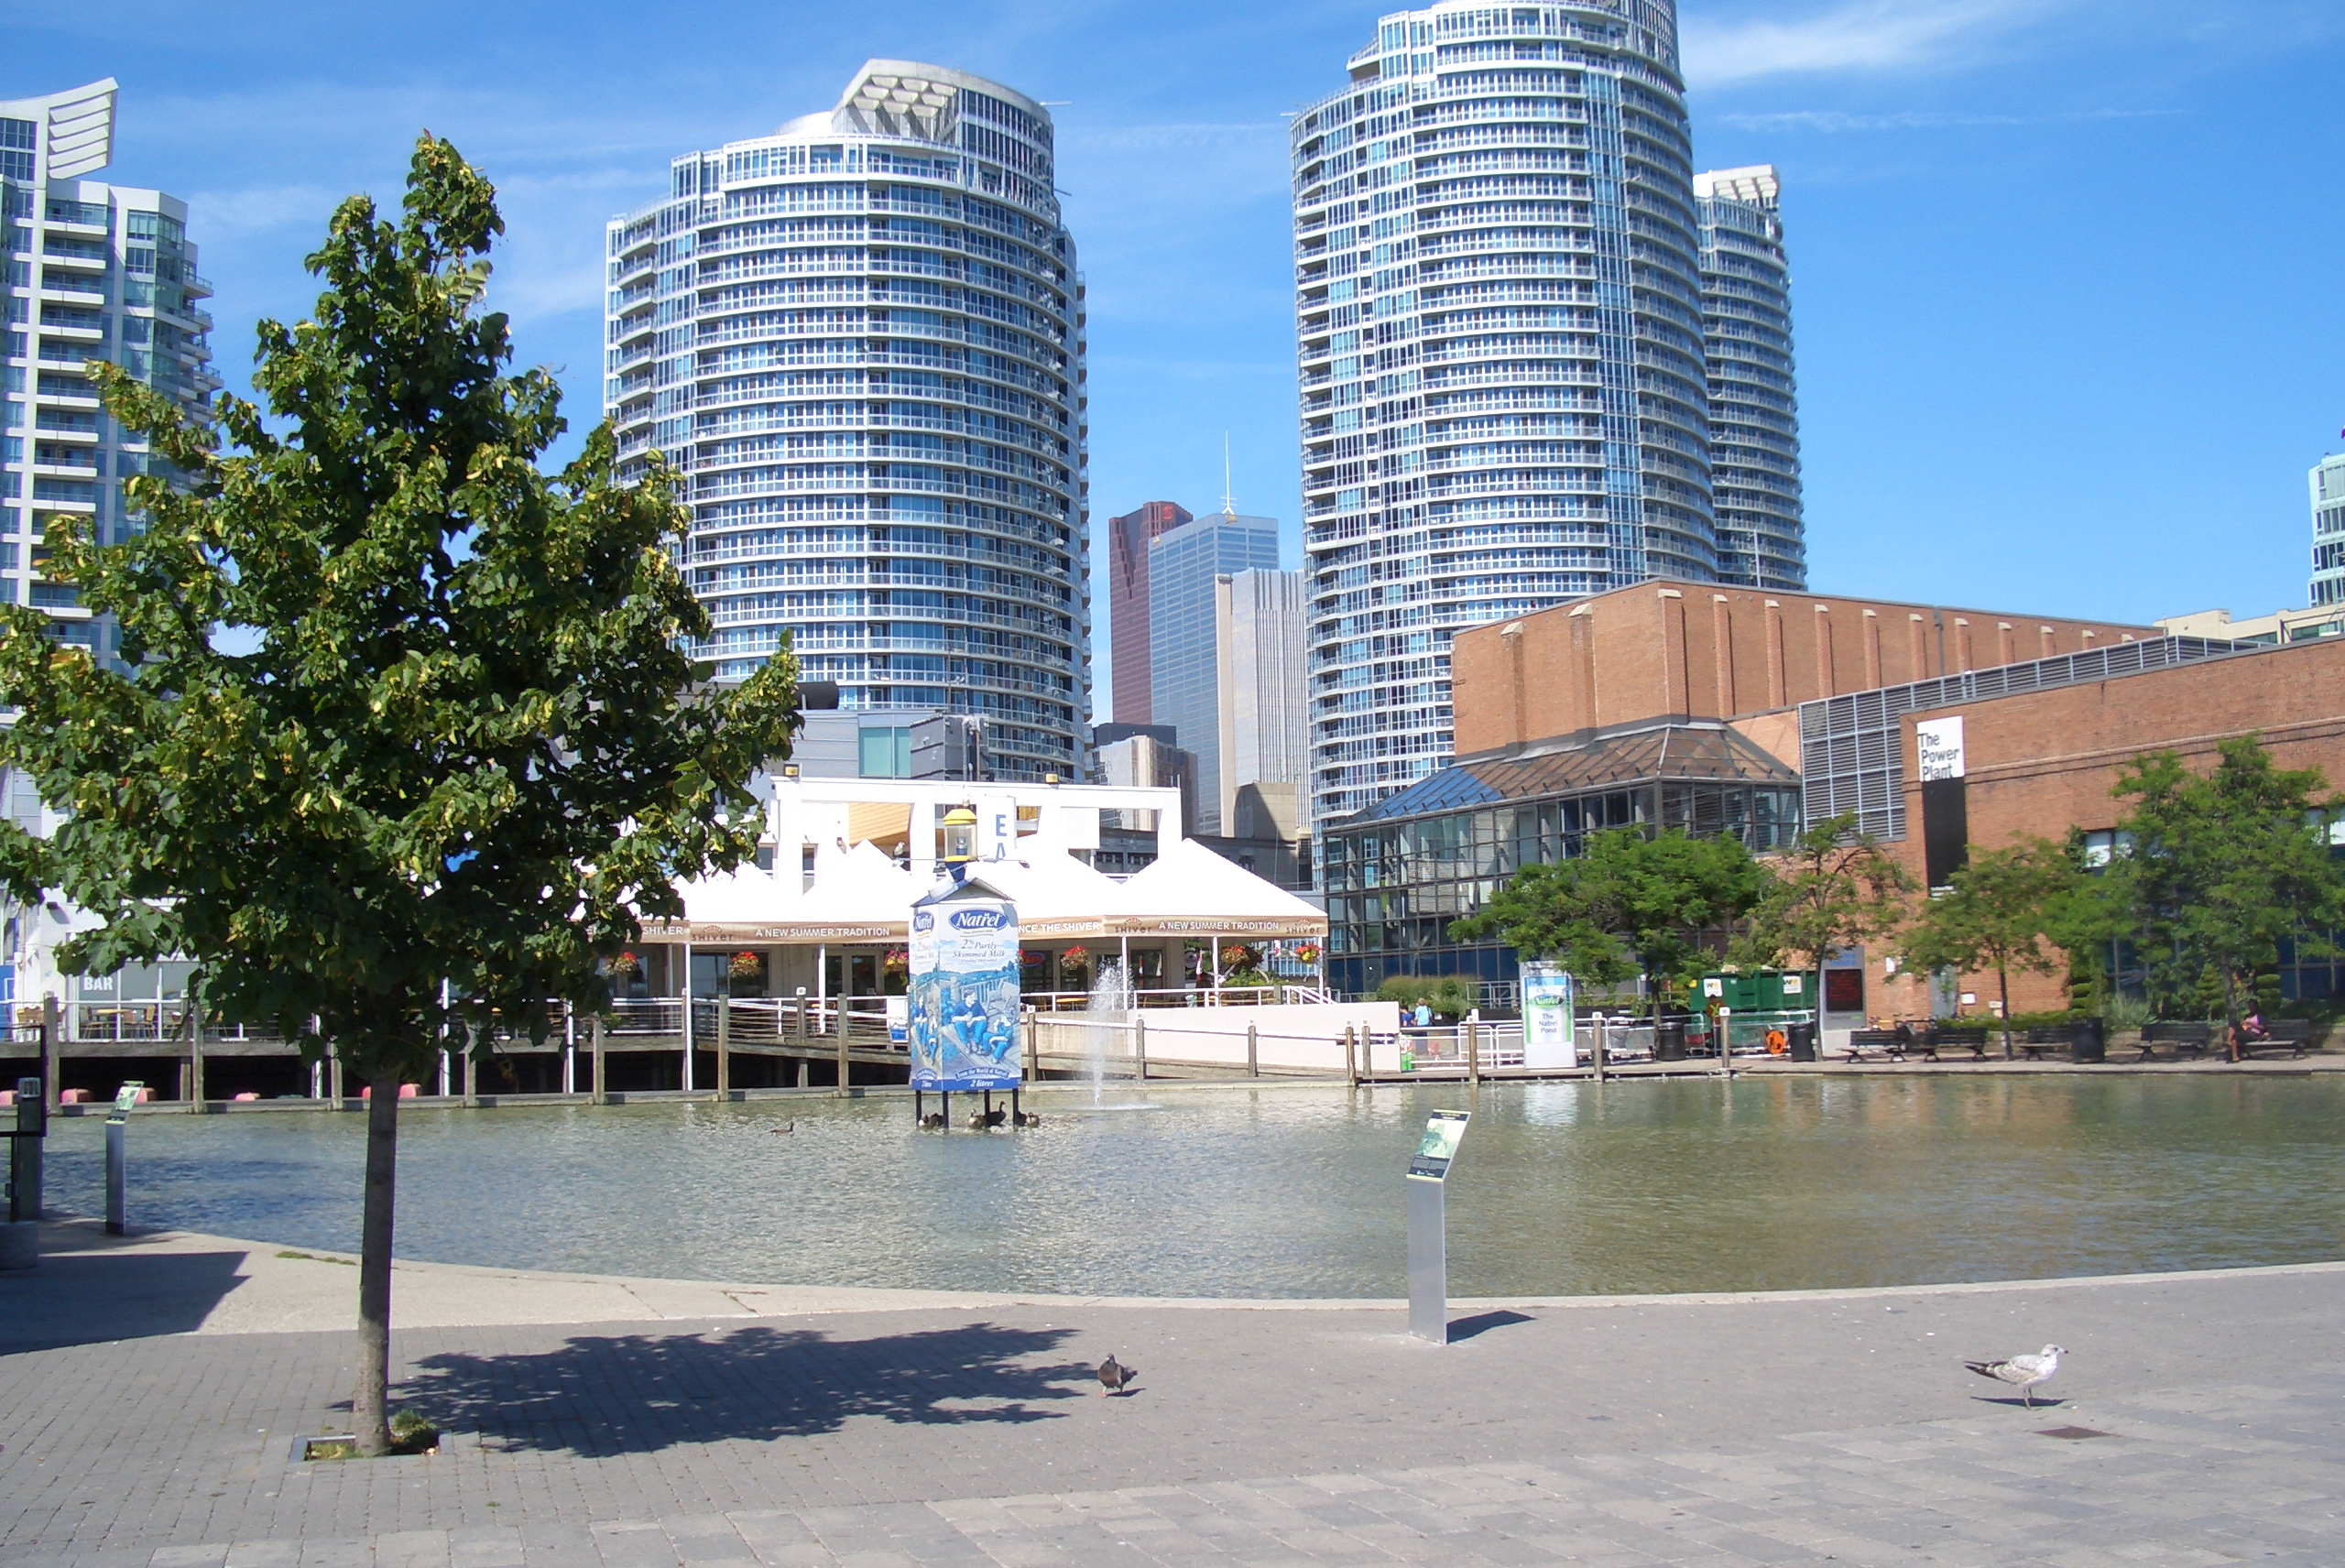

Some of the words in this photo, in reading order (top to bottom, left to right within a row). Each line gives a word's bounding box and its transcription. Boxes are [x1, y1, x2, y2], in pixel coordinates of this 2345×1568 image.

[1917, 733, 1940, 747] The
[1921, 748, 1959, 764] Power
[1922, 763, 1953, 781] Plant
[641, 926, 683, 935] SHIVER
[1041, 923, 1061, 932] THE
[1063, 921, 1099, 931] SHIVER
[1167, 921, 1189, 930] NEW
[1190, 921, 1229, 931] SUMMER
[1231, 921, 1280, 931] TRADITION
[755, 929, 763, 937] A
[765, 928, 789, 937] NEW
[790, 928, 834, 937] SUMMER
[836, 927, 890, 936] TRADITION
[975, 941, 998, 950] Partly
[988, 950, 1005, 958] Milk
[84, 976, 113, 990] BAR
